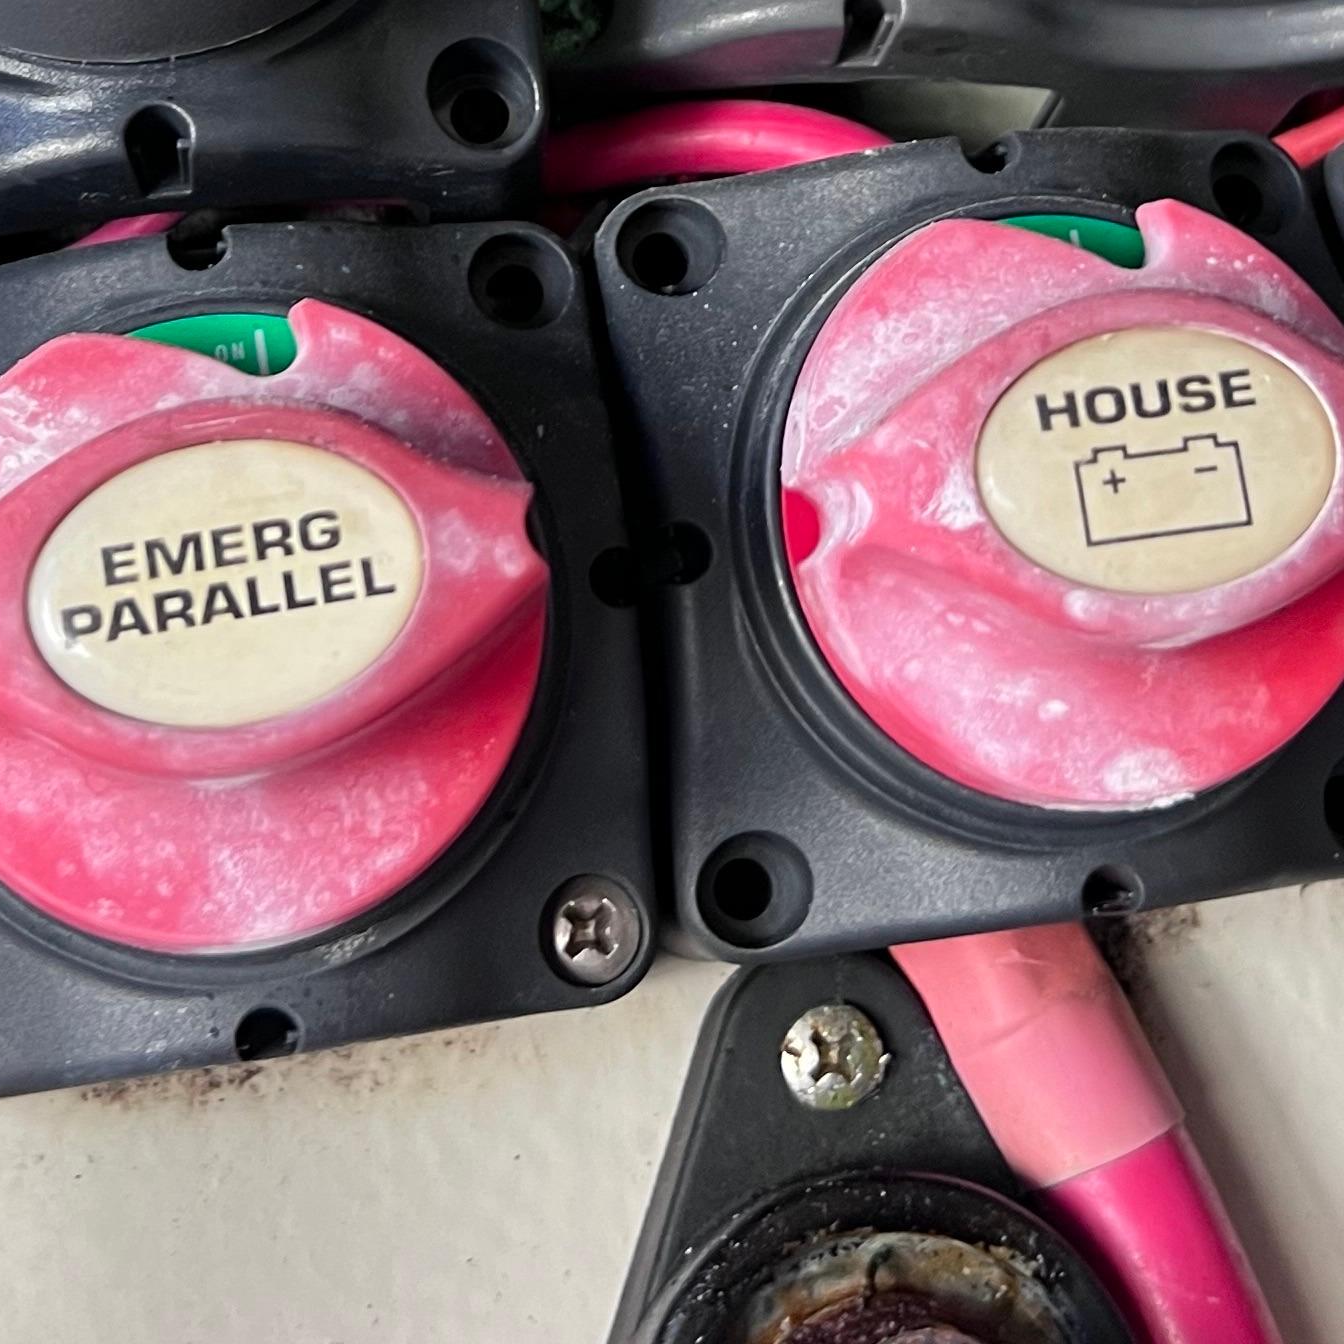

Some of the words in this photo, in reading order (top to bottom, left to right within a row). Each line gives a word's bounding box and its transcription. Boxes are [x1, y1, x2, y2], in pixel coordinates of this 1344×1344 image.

[214, 340, 246, 362] ON
[1035, 368, 1257, 433] HOUSE
[101, 509, 343, 588] EMERG
[61, 556, 398, 649] PARALLEL
